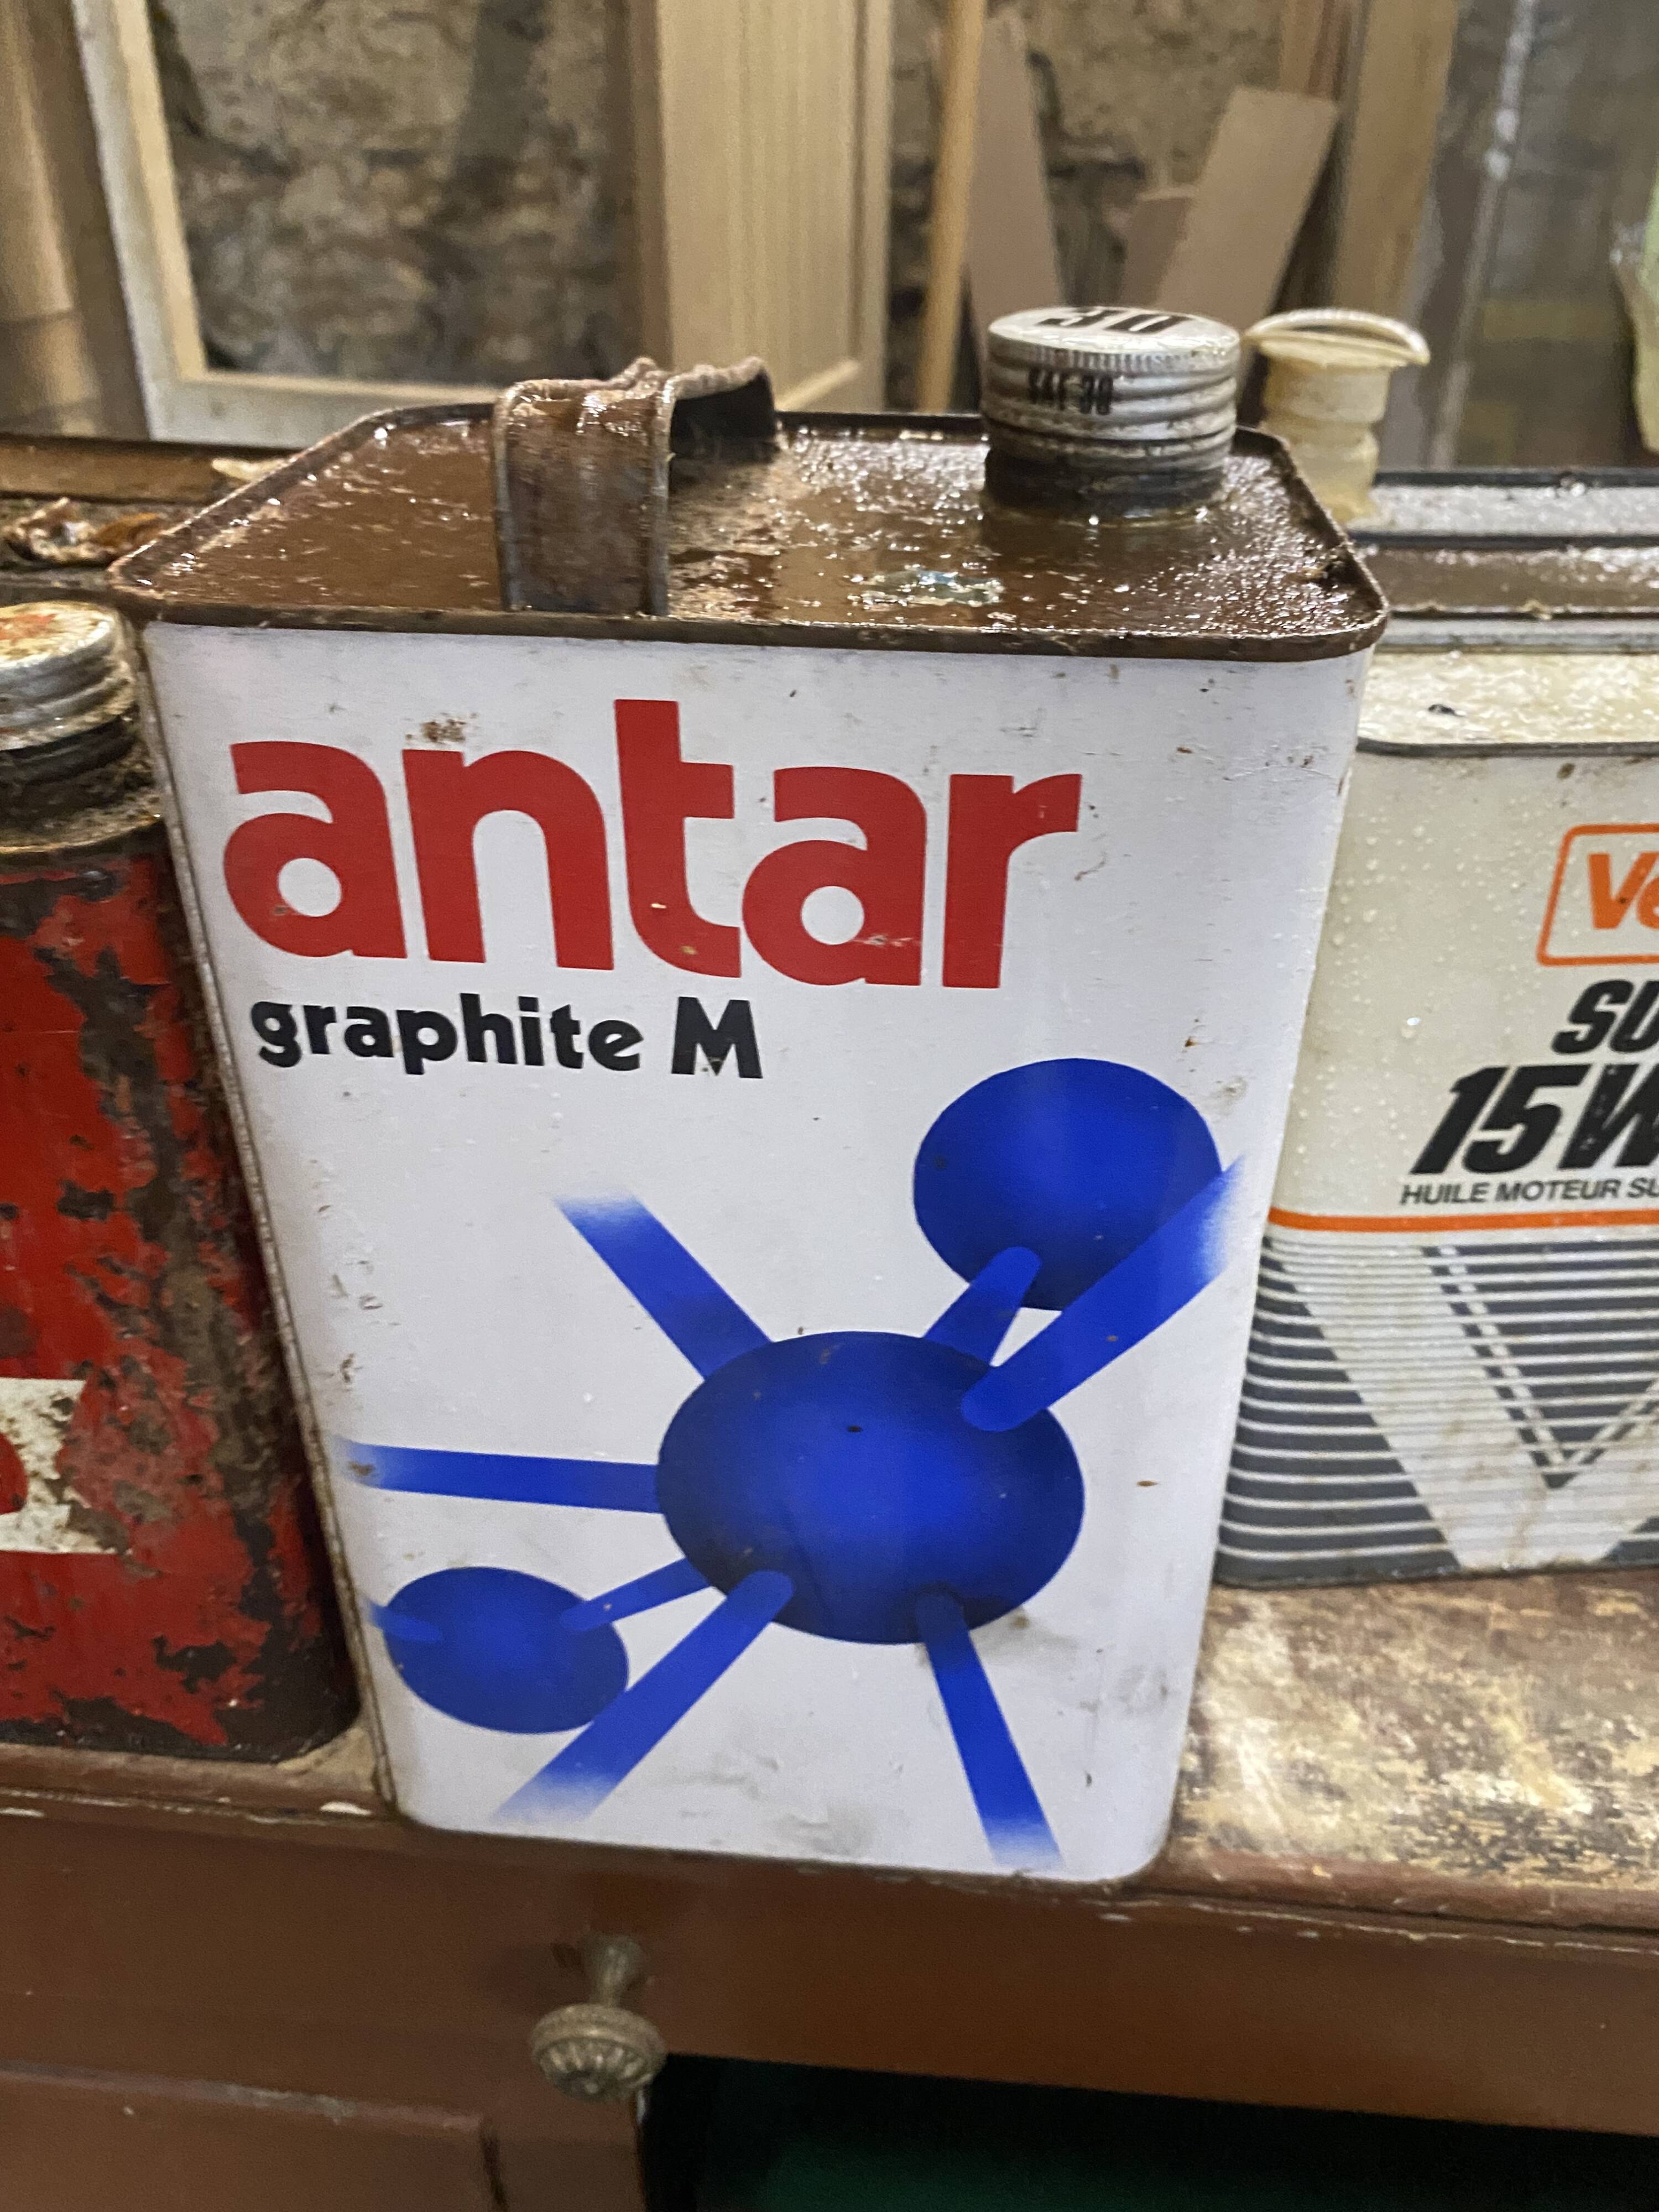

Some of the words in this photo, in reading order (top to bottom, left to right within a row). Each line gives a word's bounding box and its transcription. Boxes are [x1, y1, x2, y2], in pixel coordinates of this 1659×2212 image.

[224, 699, 1081, 989] antar
[250, 993, 644, 1076] graphite
[671, 996, 763, 1079] M
[1410, 1064, 1659, 1175] 15W
[1399, 1182, 1490, 1206] HUILE
[1495, 1178, 1621, 1202] MOTEUR
